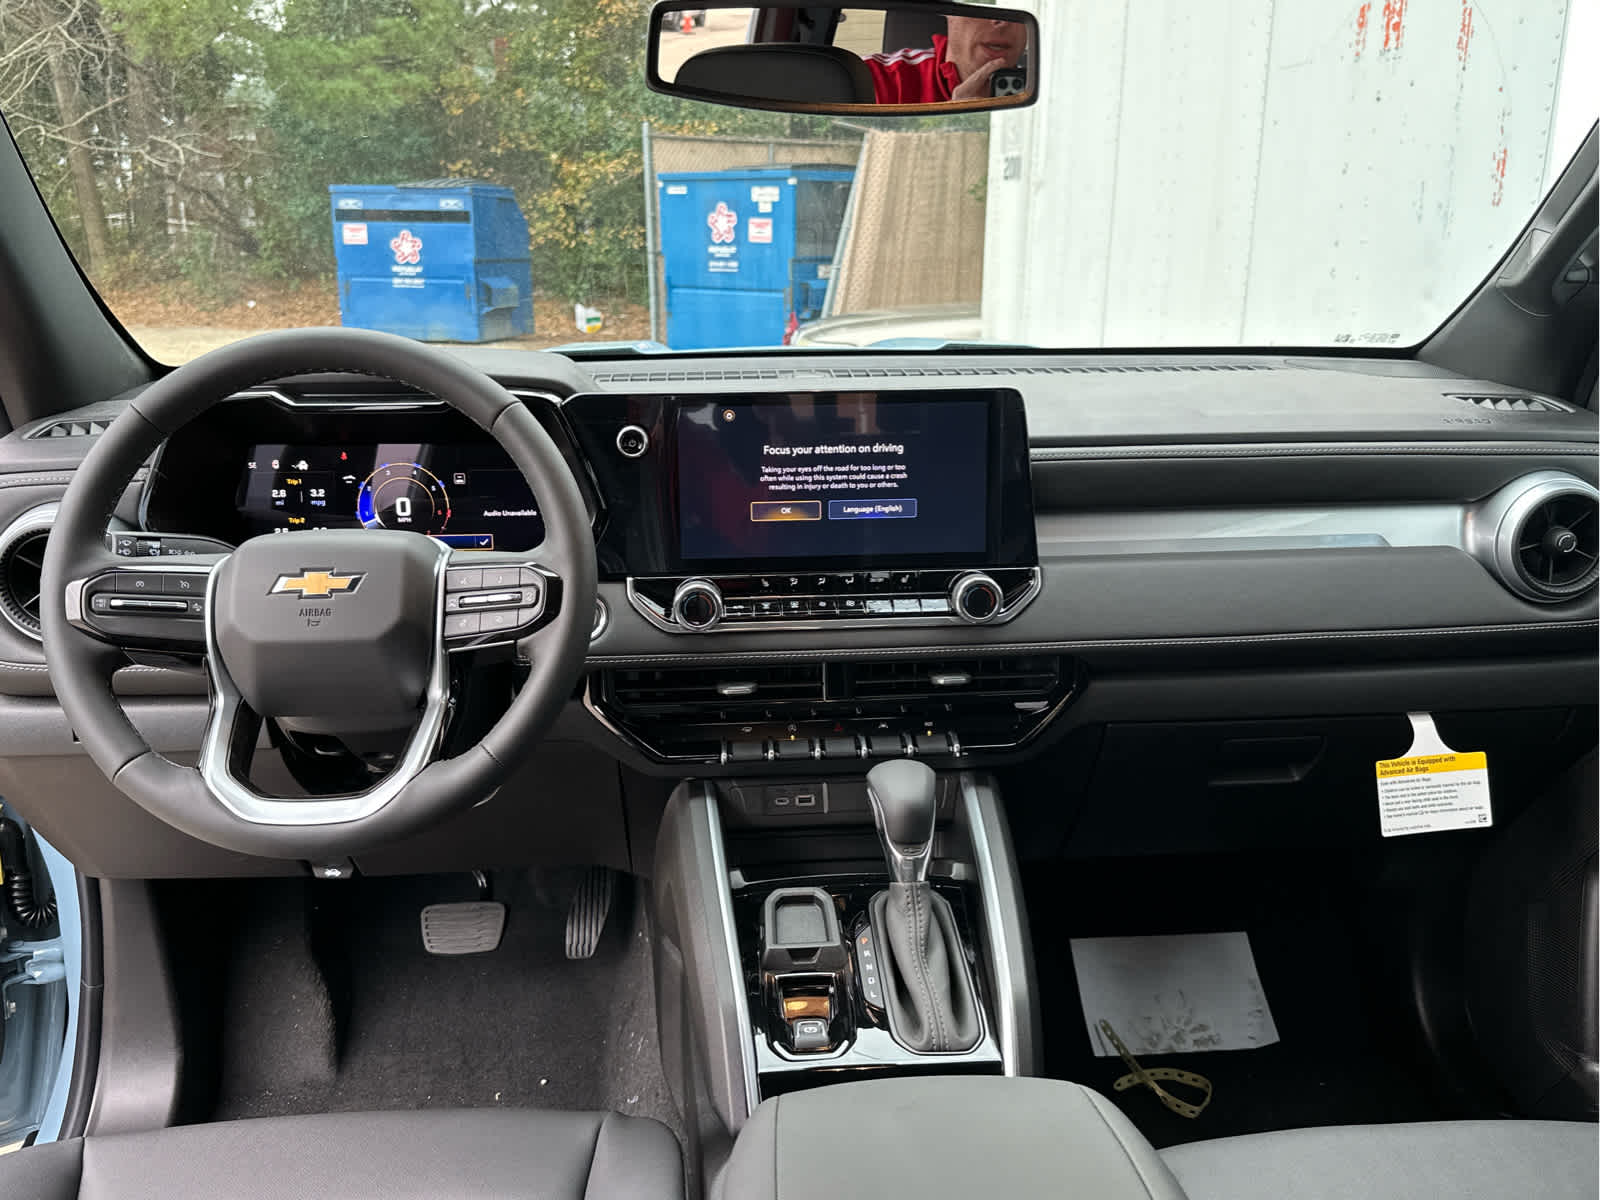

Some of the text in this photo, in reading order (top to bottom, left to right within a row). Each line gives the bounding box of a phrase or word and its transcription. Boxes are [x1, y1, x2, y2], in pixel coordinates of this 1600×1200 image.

[763, 443, 904, 456] Focus your attention on driving
[761, 466, 782, 474] Taking
[872, 464, 886, 472] long
[768, 484, 796, 492] resulting
[804, 483, 821, 491] injury
[310, 488, 326, 497] 3.2
[396, 497, 411, 517] 0
[843, 505, 903, 514] Language (English)
[299, 608, 332, 617] AIRBAG
